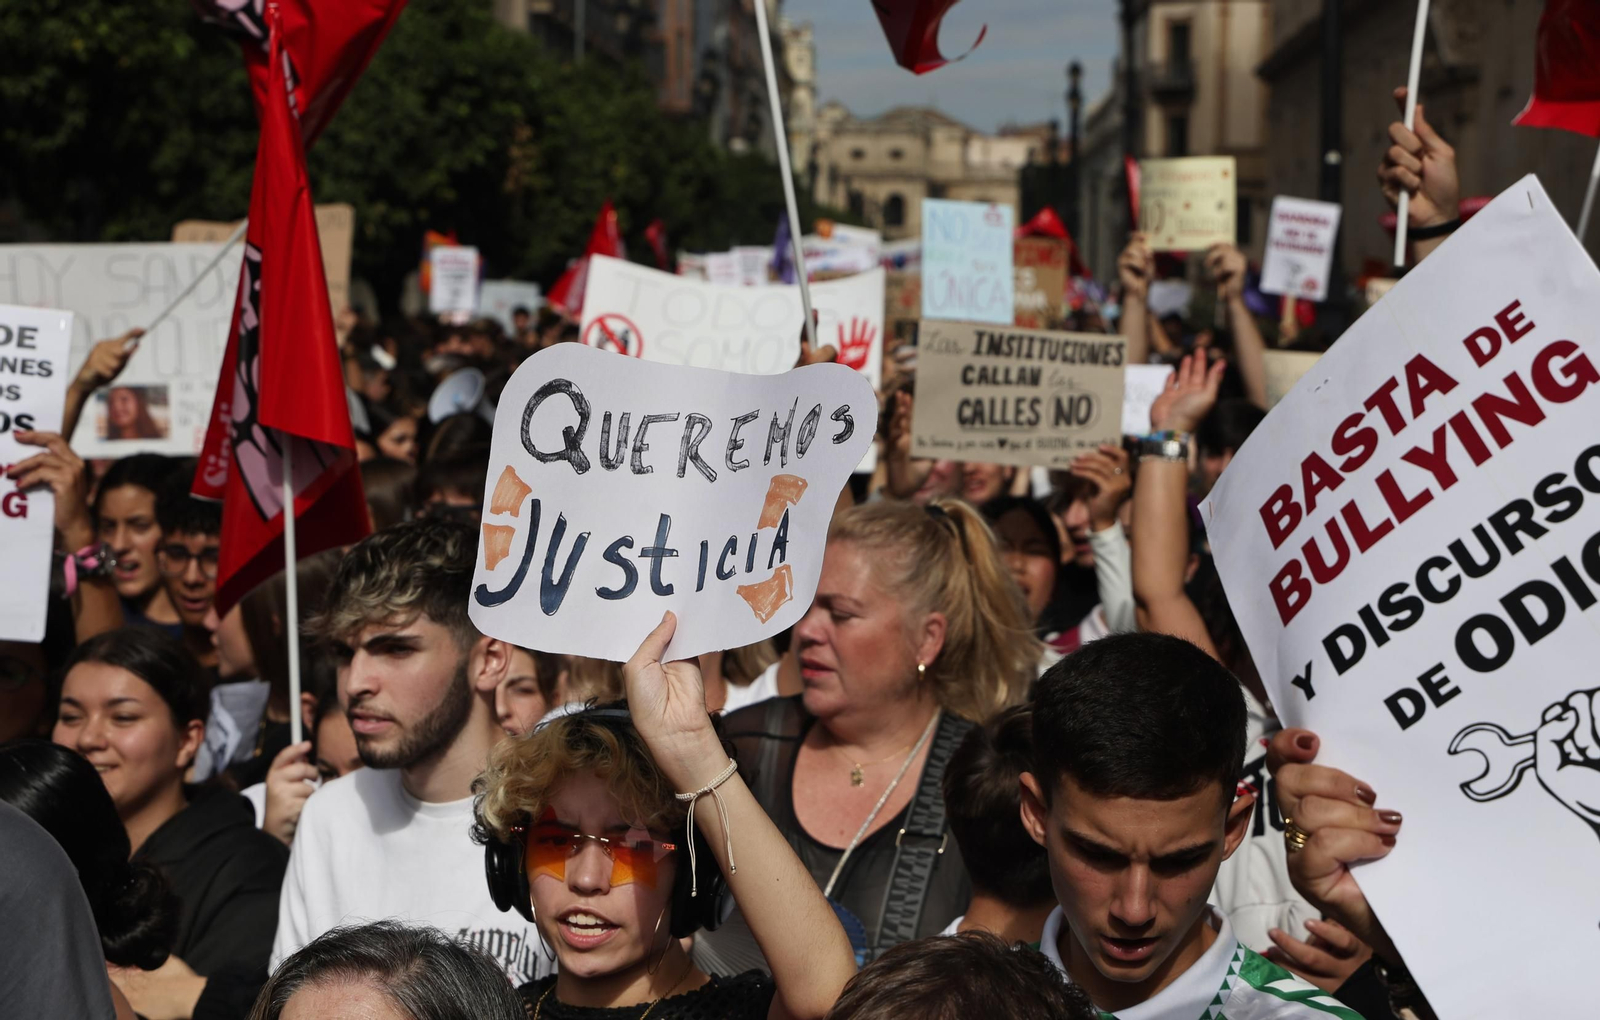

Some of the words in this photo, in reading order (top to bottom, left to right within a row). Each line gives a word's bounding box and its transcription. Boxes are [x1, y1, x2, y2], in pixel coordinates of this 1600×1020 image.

[961, 364, 1042, 387] CALLAN
[973, 329, 1125, 367] INSTITUCIONES
[520, 377, 854, 483] QUEREMOS
[956, 396, 1042, 427] CALLES
[1053, 393, 1093, 426] NO
[1258, 353, 1459, 551] BASTA
[1462, 299, 1536, 368] DE
[1268, 339, 1600, 627] BULLYING
[1290, 659, 1314, 702] Y
[1383, 662, 1463, 730] DE
